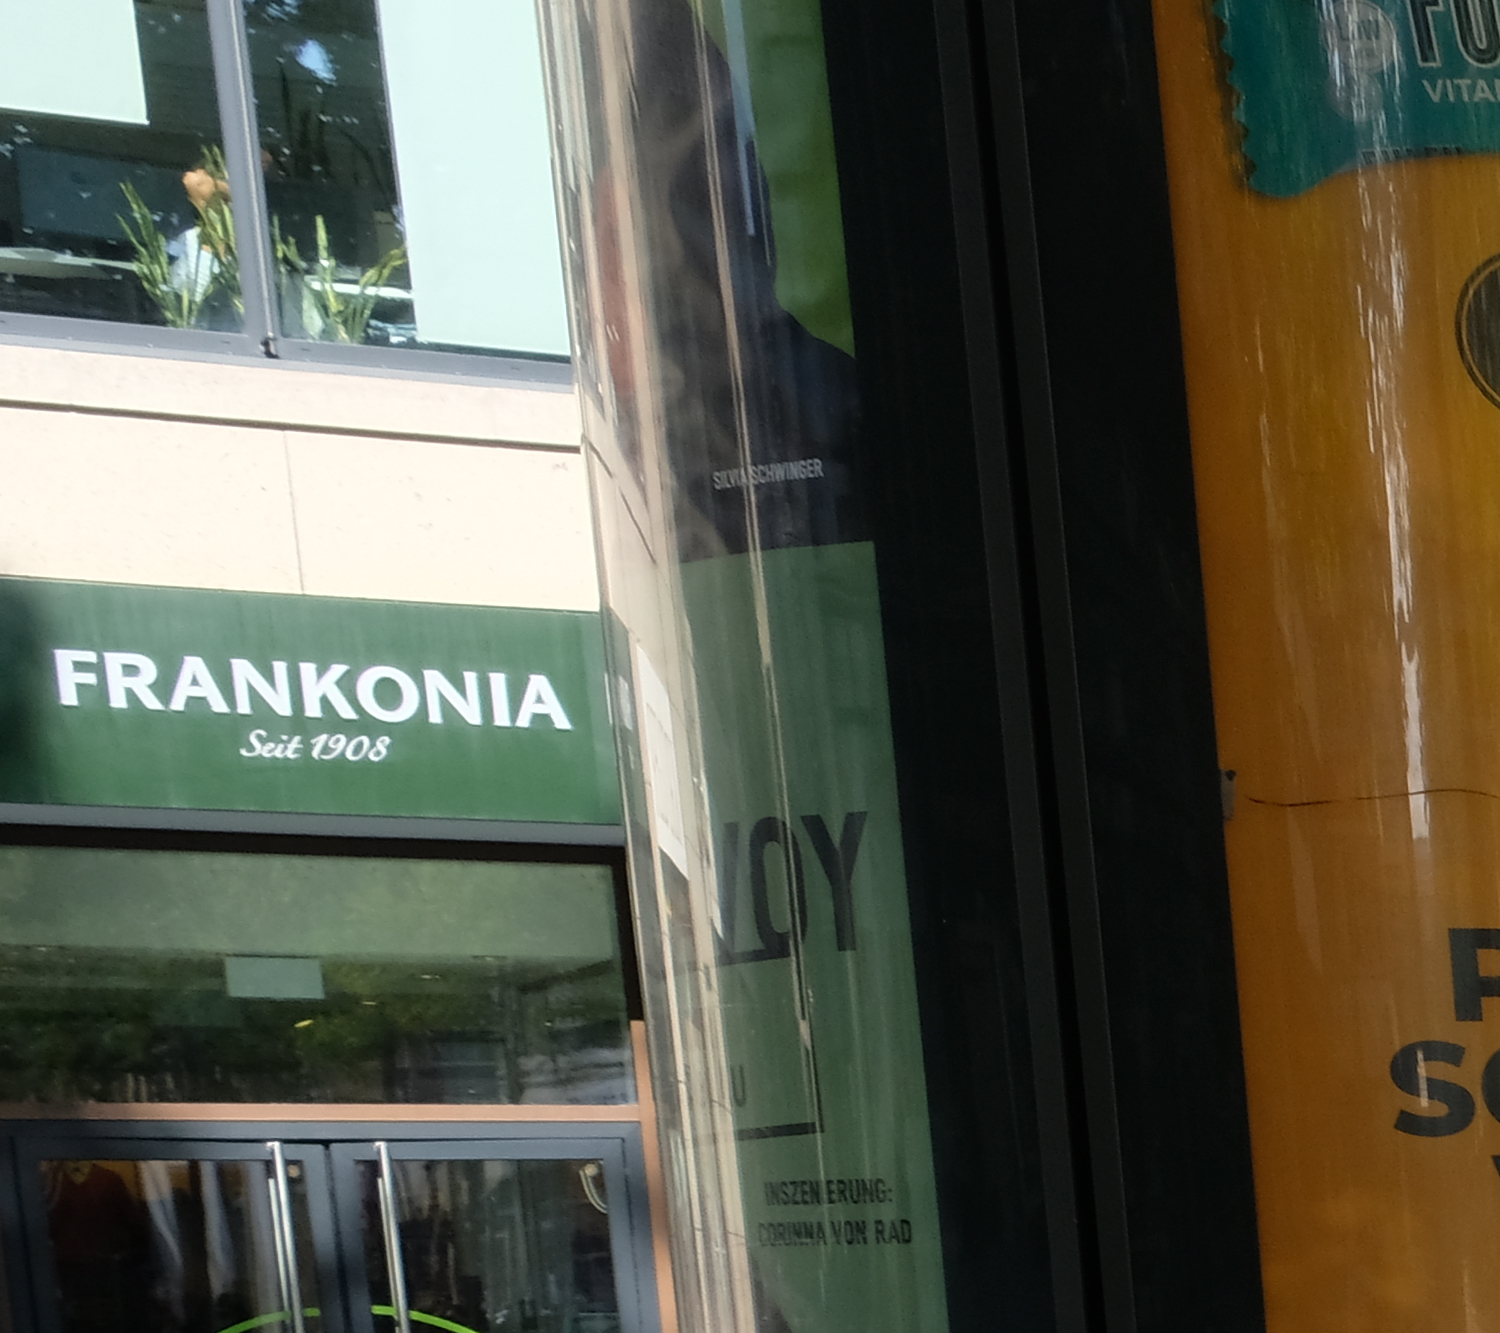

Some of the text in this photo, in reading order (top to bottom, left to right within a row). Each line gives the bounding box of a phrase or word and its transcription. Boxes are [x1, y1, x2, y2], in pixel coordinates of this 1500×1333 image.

[53, 646, 575, 731] FRANKONIA
[239, 728, 392, 764] Seit 1908
[830, 1219, 868, 1246] VON
[874, 1218, 913, 1246] RAD
